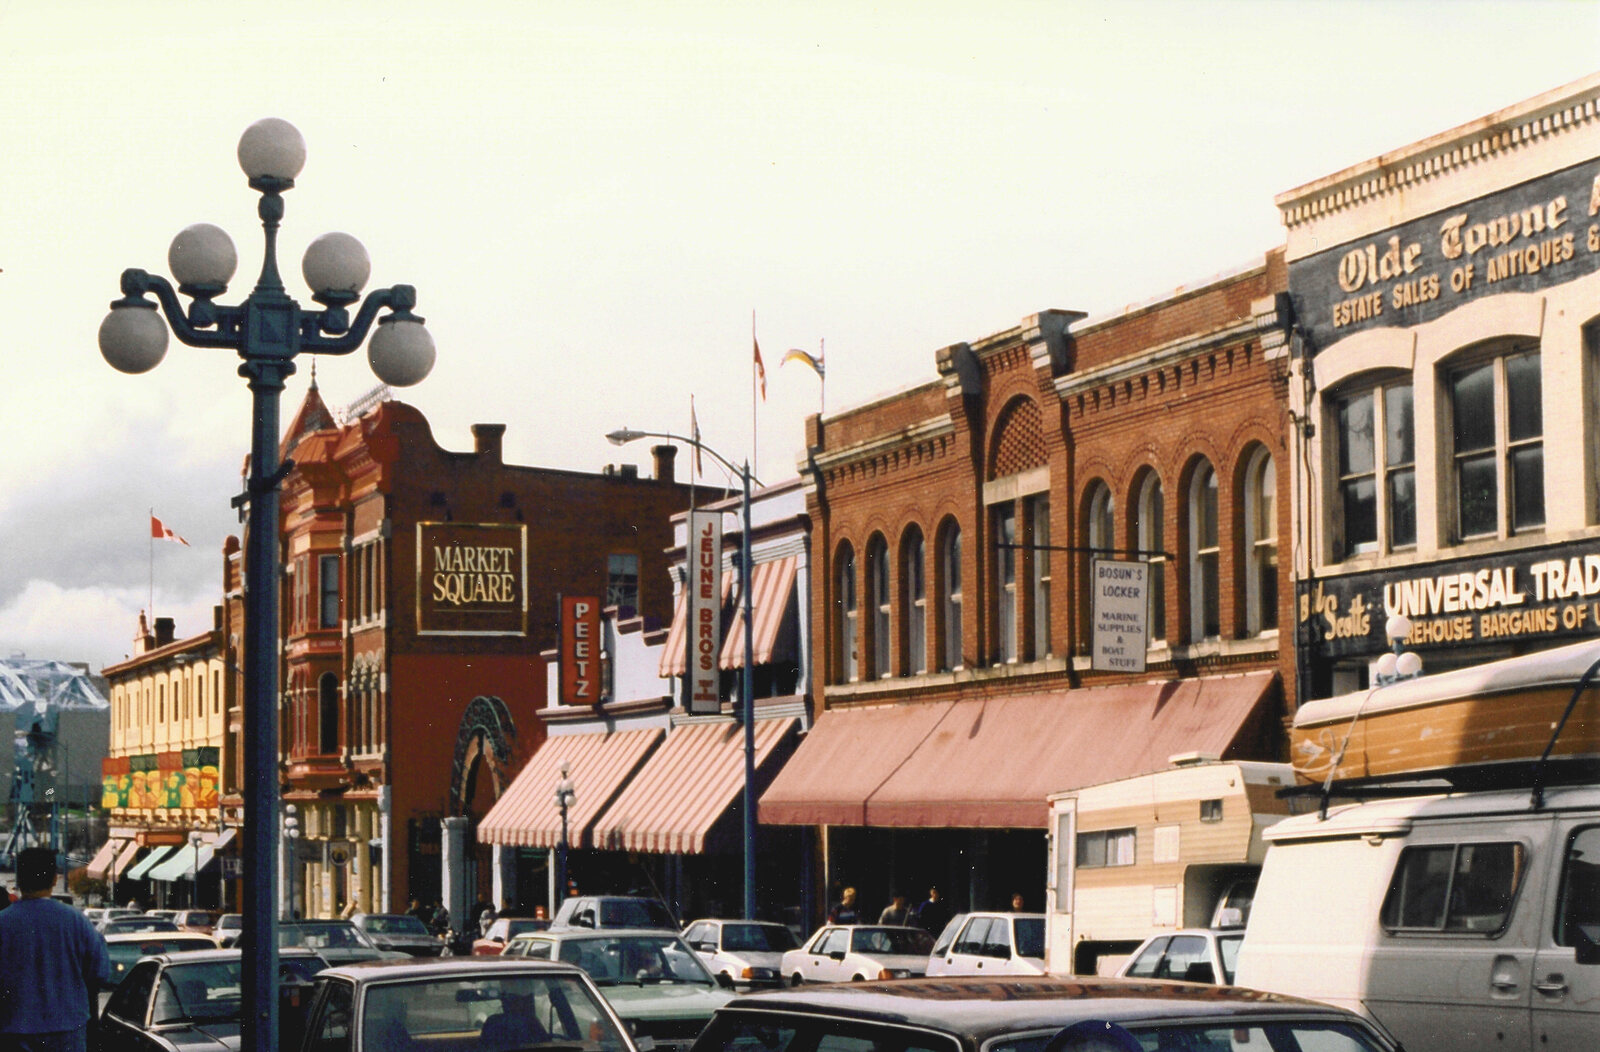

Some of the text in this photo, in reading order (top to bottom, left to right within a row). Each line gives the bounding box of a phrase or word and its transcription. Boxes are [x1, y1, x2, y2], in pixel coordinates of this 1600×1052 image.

[1338, 234, 1422, 292] Olde
[1439, 195, 1569, 260] Towne
[1333, 291, 1383, 328] ESTATE
[1392, 272, 1440, 310] SALES
[1450, 266, 1474, 293] OF
[1487, 232, 1575, 284] ANTIQUES
[434, 546, 514, 573] MARKET
[700, 522, 714, 599] JEUNE
[1099, 566, 1142, 580] BOSUN'S
[433, 572, 515, 605] SQUARE
[1103, 585, 1140, 598] LOCKER
[1384, 554, 1600, 617] UNIVERSAL TRAD
[1098, 624, 1142, 634] SUPPLIES
[1102, 611, 1139, 622] MARINE
[1480, 607, 1557, 638] BARGAINS
[1563, 604, 1587, 630] OF
[575, 602, 590, 697] PEETZ
[699, 608, 714, 671] BROS
[1102, 646, 1125, 656] BOAT
[1116, 635, 1124, 644] &
[1109, 658, 1137, 668] STUFF
